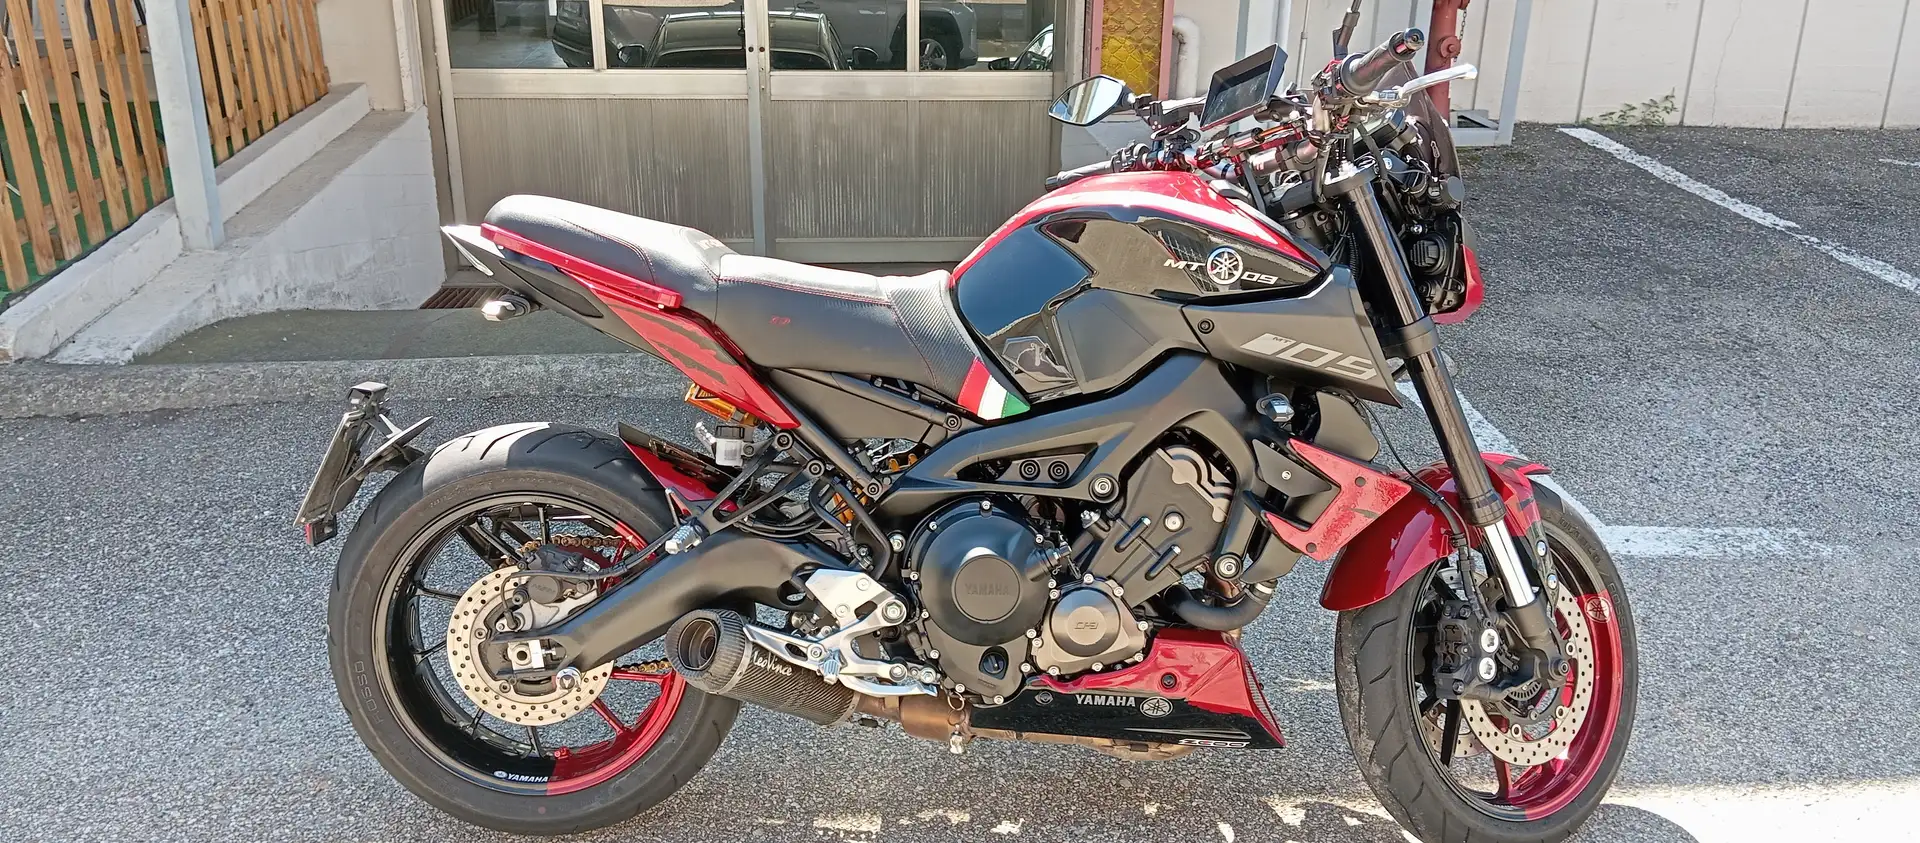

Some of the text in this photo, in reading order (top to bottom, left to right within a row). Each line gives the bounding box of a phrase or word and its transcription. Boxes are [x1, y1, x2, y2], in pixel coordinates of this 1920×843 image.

[1163, 259, 1279, 285] MT 09
[1272, 336, 1293, 344] MT
[964, 582, 1010, 596] YAMAHA
[353, 660, 383, 724] ROSSO
[1075, 694, 1136, 708] YAMAHA
[507, 773, 549, 783] YAMAHA
